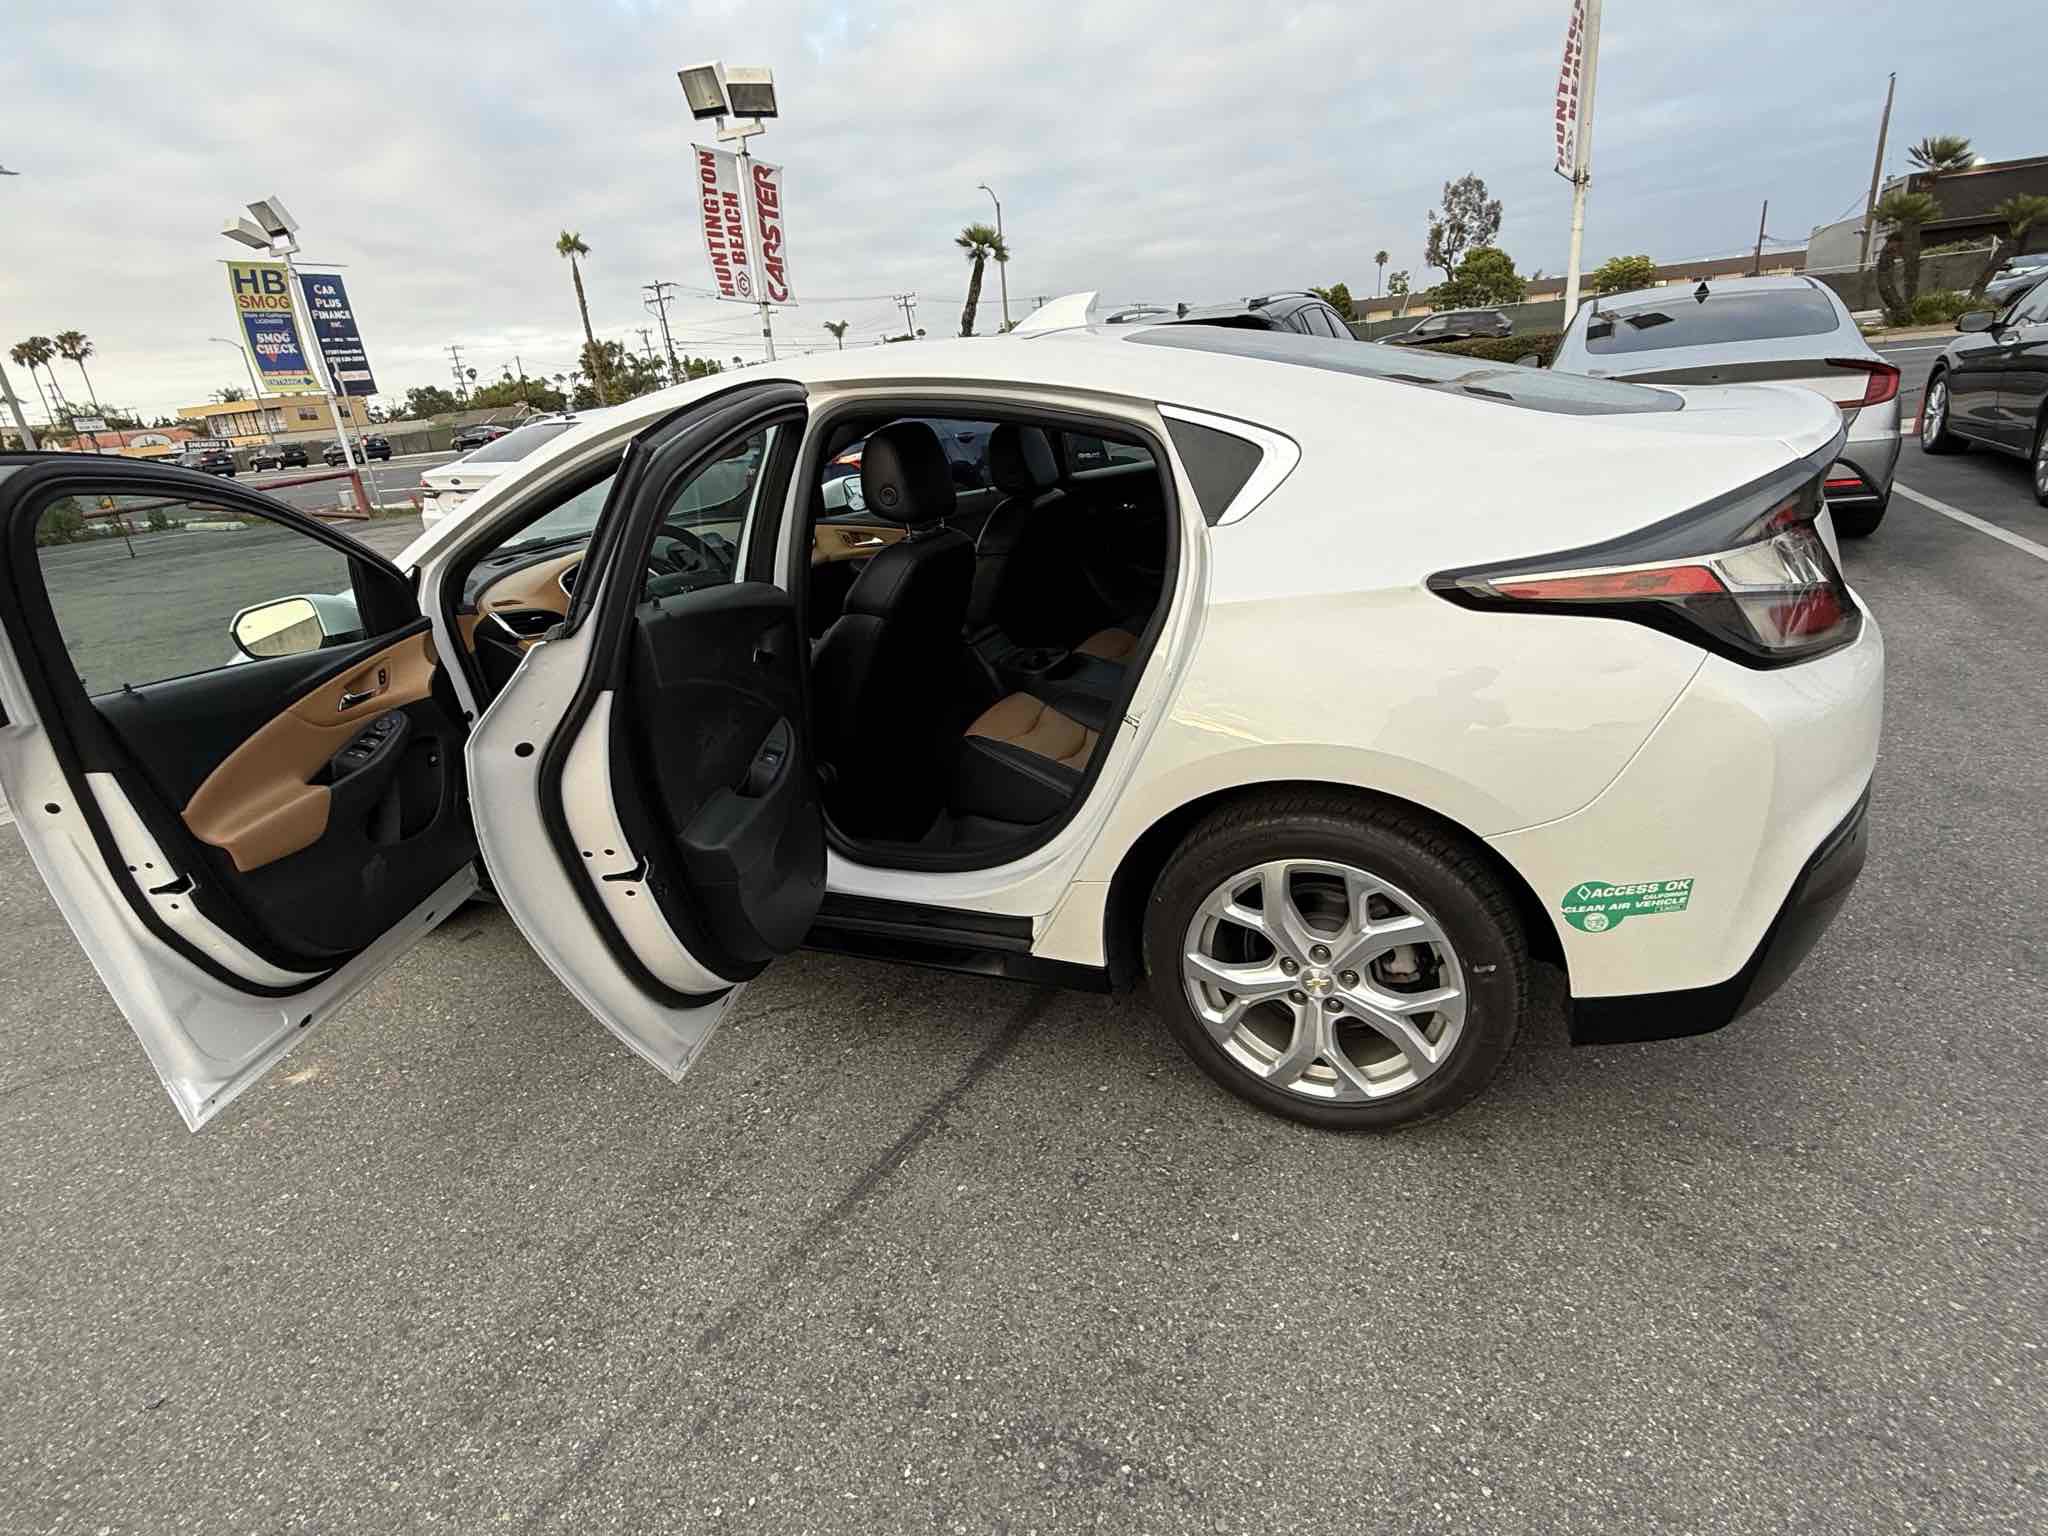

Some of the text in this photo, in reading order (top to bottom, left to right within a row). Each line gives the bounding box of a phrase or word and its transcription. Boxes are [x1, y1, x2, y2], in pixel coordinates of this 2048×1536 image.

[699, 150, 736, 297] HUNTINGTON
[722, 191, 747, 265] BEACH
[753, 164, 789, 302] CARSTER
[232, 268, 286, 294] HB
[314, 284, 336, 294] CAR
[239, 295, 290, 309] SMOG
[315, 298, 342, 308] PLUS
[312, 309, 352, 320] FINANCE
[256, 332, 291, 343] SMOG
[256, 343, 298, 354] CHECK
[1590, 880, 1691, 898] ACCESS OK
[1564, 904, 1606, 913] CLEAN
[1608, 902, 1631, 911] AIR
[1636, 897, 1687, 908] VEHICLE
